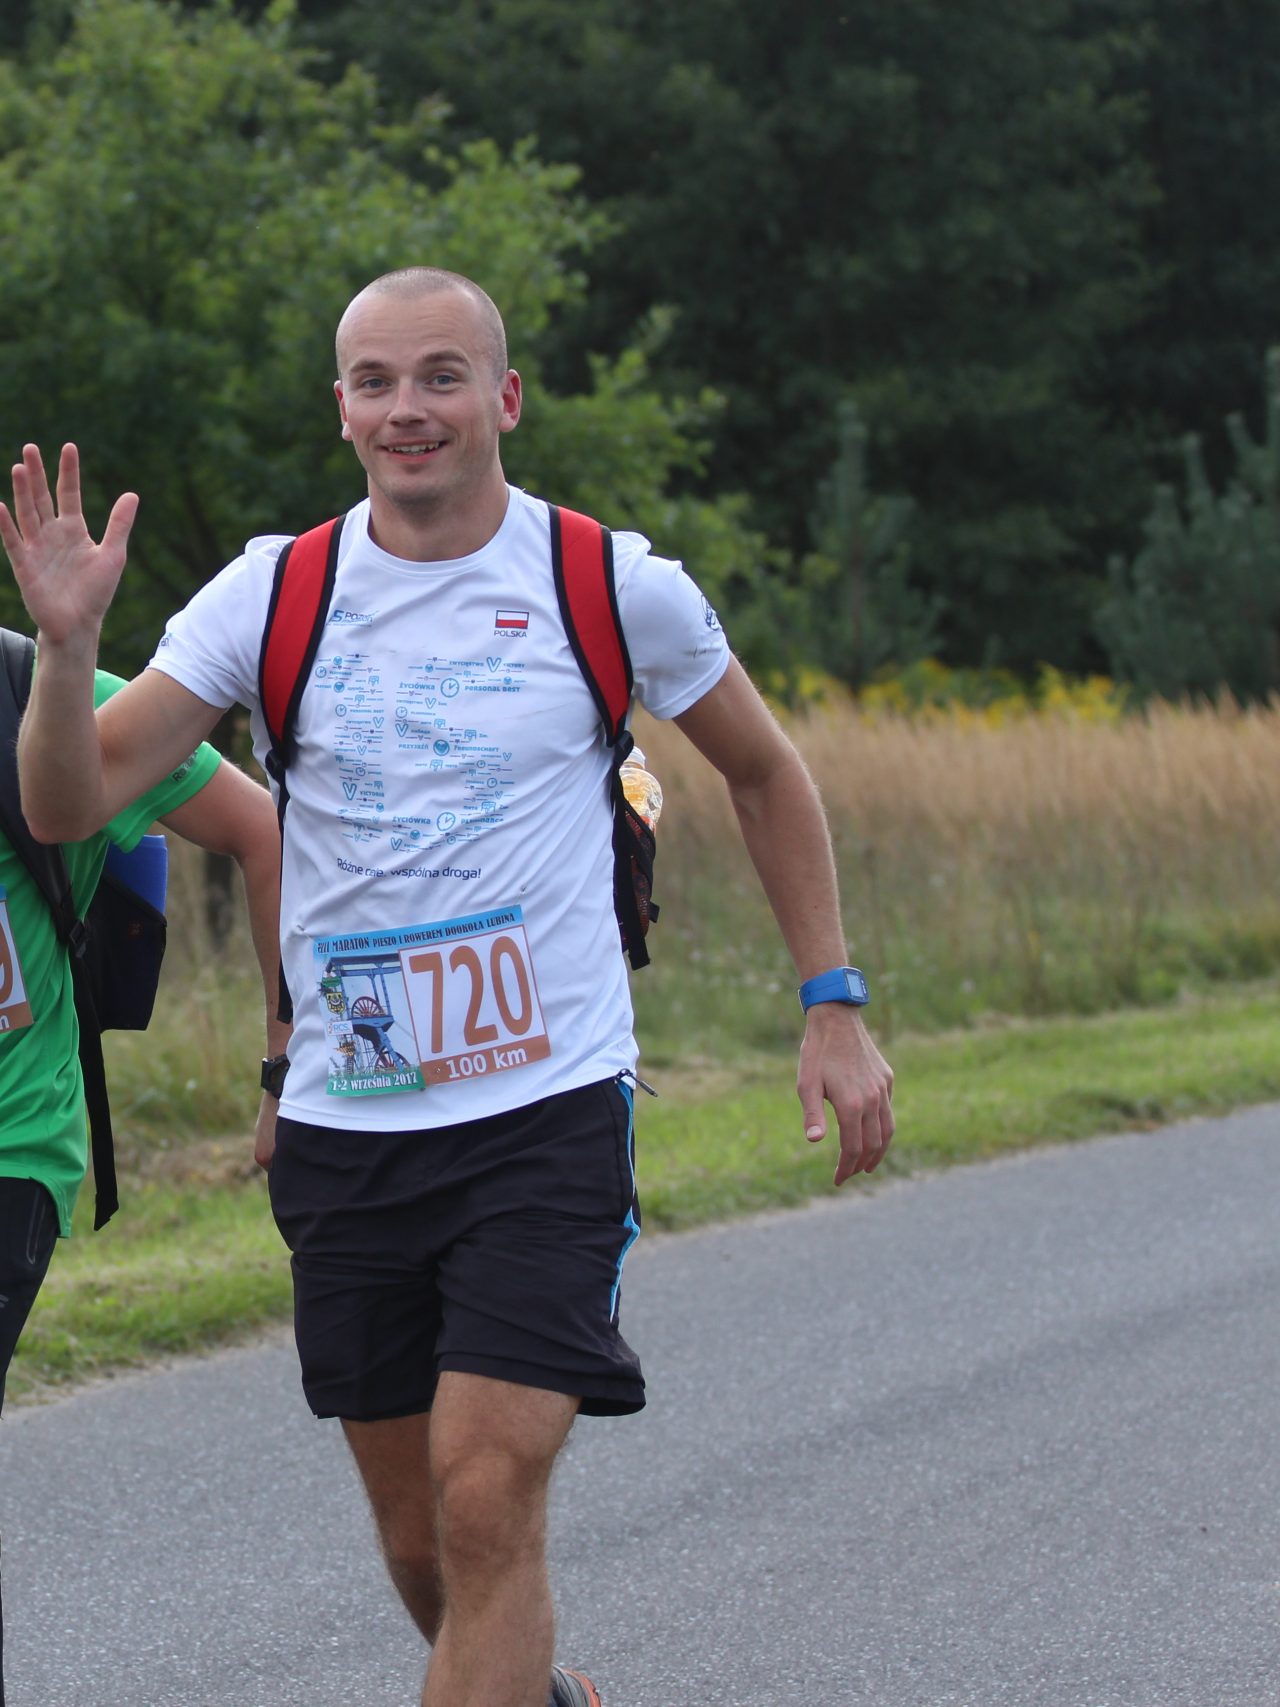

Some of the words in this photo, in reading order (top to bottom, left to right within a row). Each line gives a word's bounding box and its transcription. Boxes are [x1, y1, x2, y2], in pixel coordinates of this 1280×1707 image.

[493, 630, 528, 638] POLSKA
[336, 857, 364, 875] Różne
[390, 866, 440, 879] wspólna
[442, 866, 482, 880] droga!
[332, 936, 370, 953] MARATON
[372, 935, 397, 949] PIESZO
[404, 928, 443, 944] ROWEREM
[445, 920, 485, 937] DOOKOŁA
[486, 912, 516, 928] LUBINA
[408, 935, 533, 1054] 720
[445, 1054, 488, 1079] 100
[493, 1046, 528, 1069] km
[330, 1078, 347, 1091] 1-2
[350, 1075, 391, 1091] września
[394, 1071, 418, 1087] 2017
